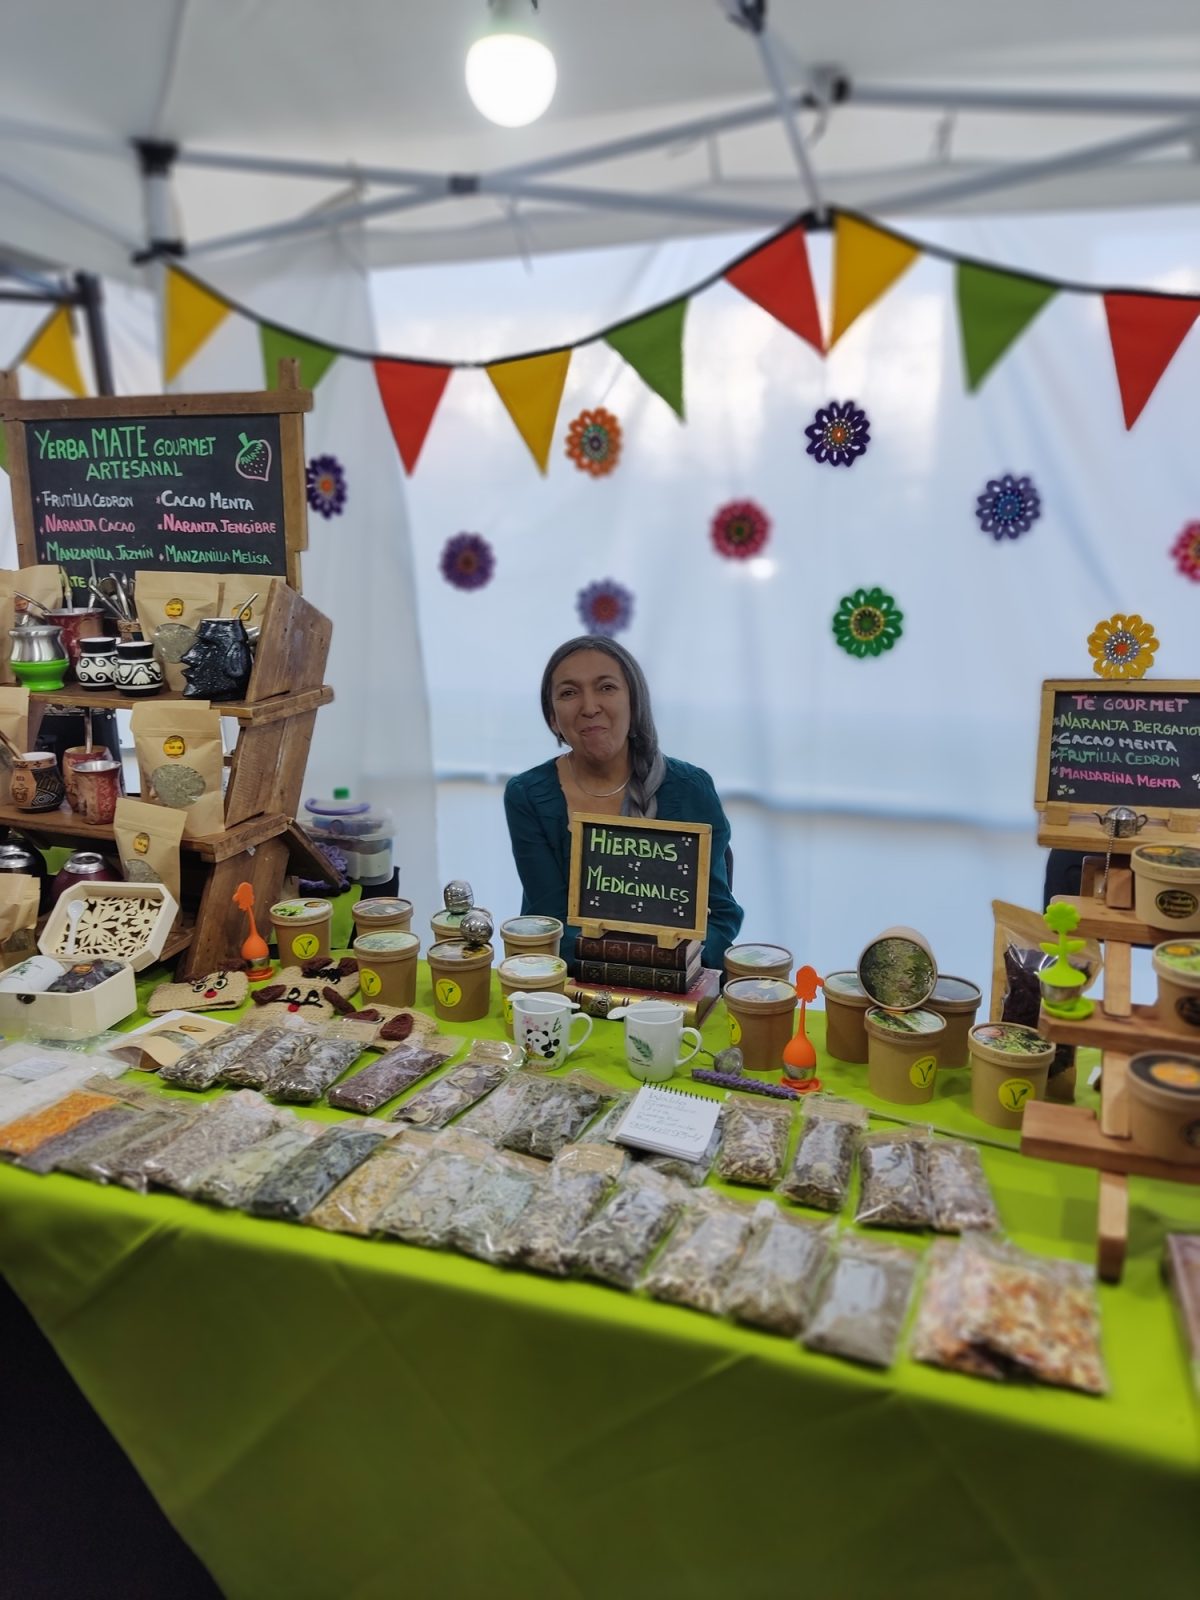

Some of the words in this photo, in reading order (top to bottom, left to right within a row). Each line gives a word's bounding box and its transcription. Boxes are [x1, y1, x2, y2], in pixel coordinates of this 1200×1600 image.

[34, 429, 90, 460] YERBA
[91, 426, 149, 458] MATE
[153, 436, 217, 456] GOURMET
[86, 460, 183, 481] ARTESANAL
[160, 489, 206, 508] CACAO
[209, 491, 254, 511] MENTA
[98, 517, 136, 533] CACAO
[1103, 698, 1190, 713] GOURMET
[1058, 732, 1115, 748] CACAO
[1119, 737, 1178, 752] MENTA
[1137, 774, 1181, 789] MENTA
